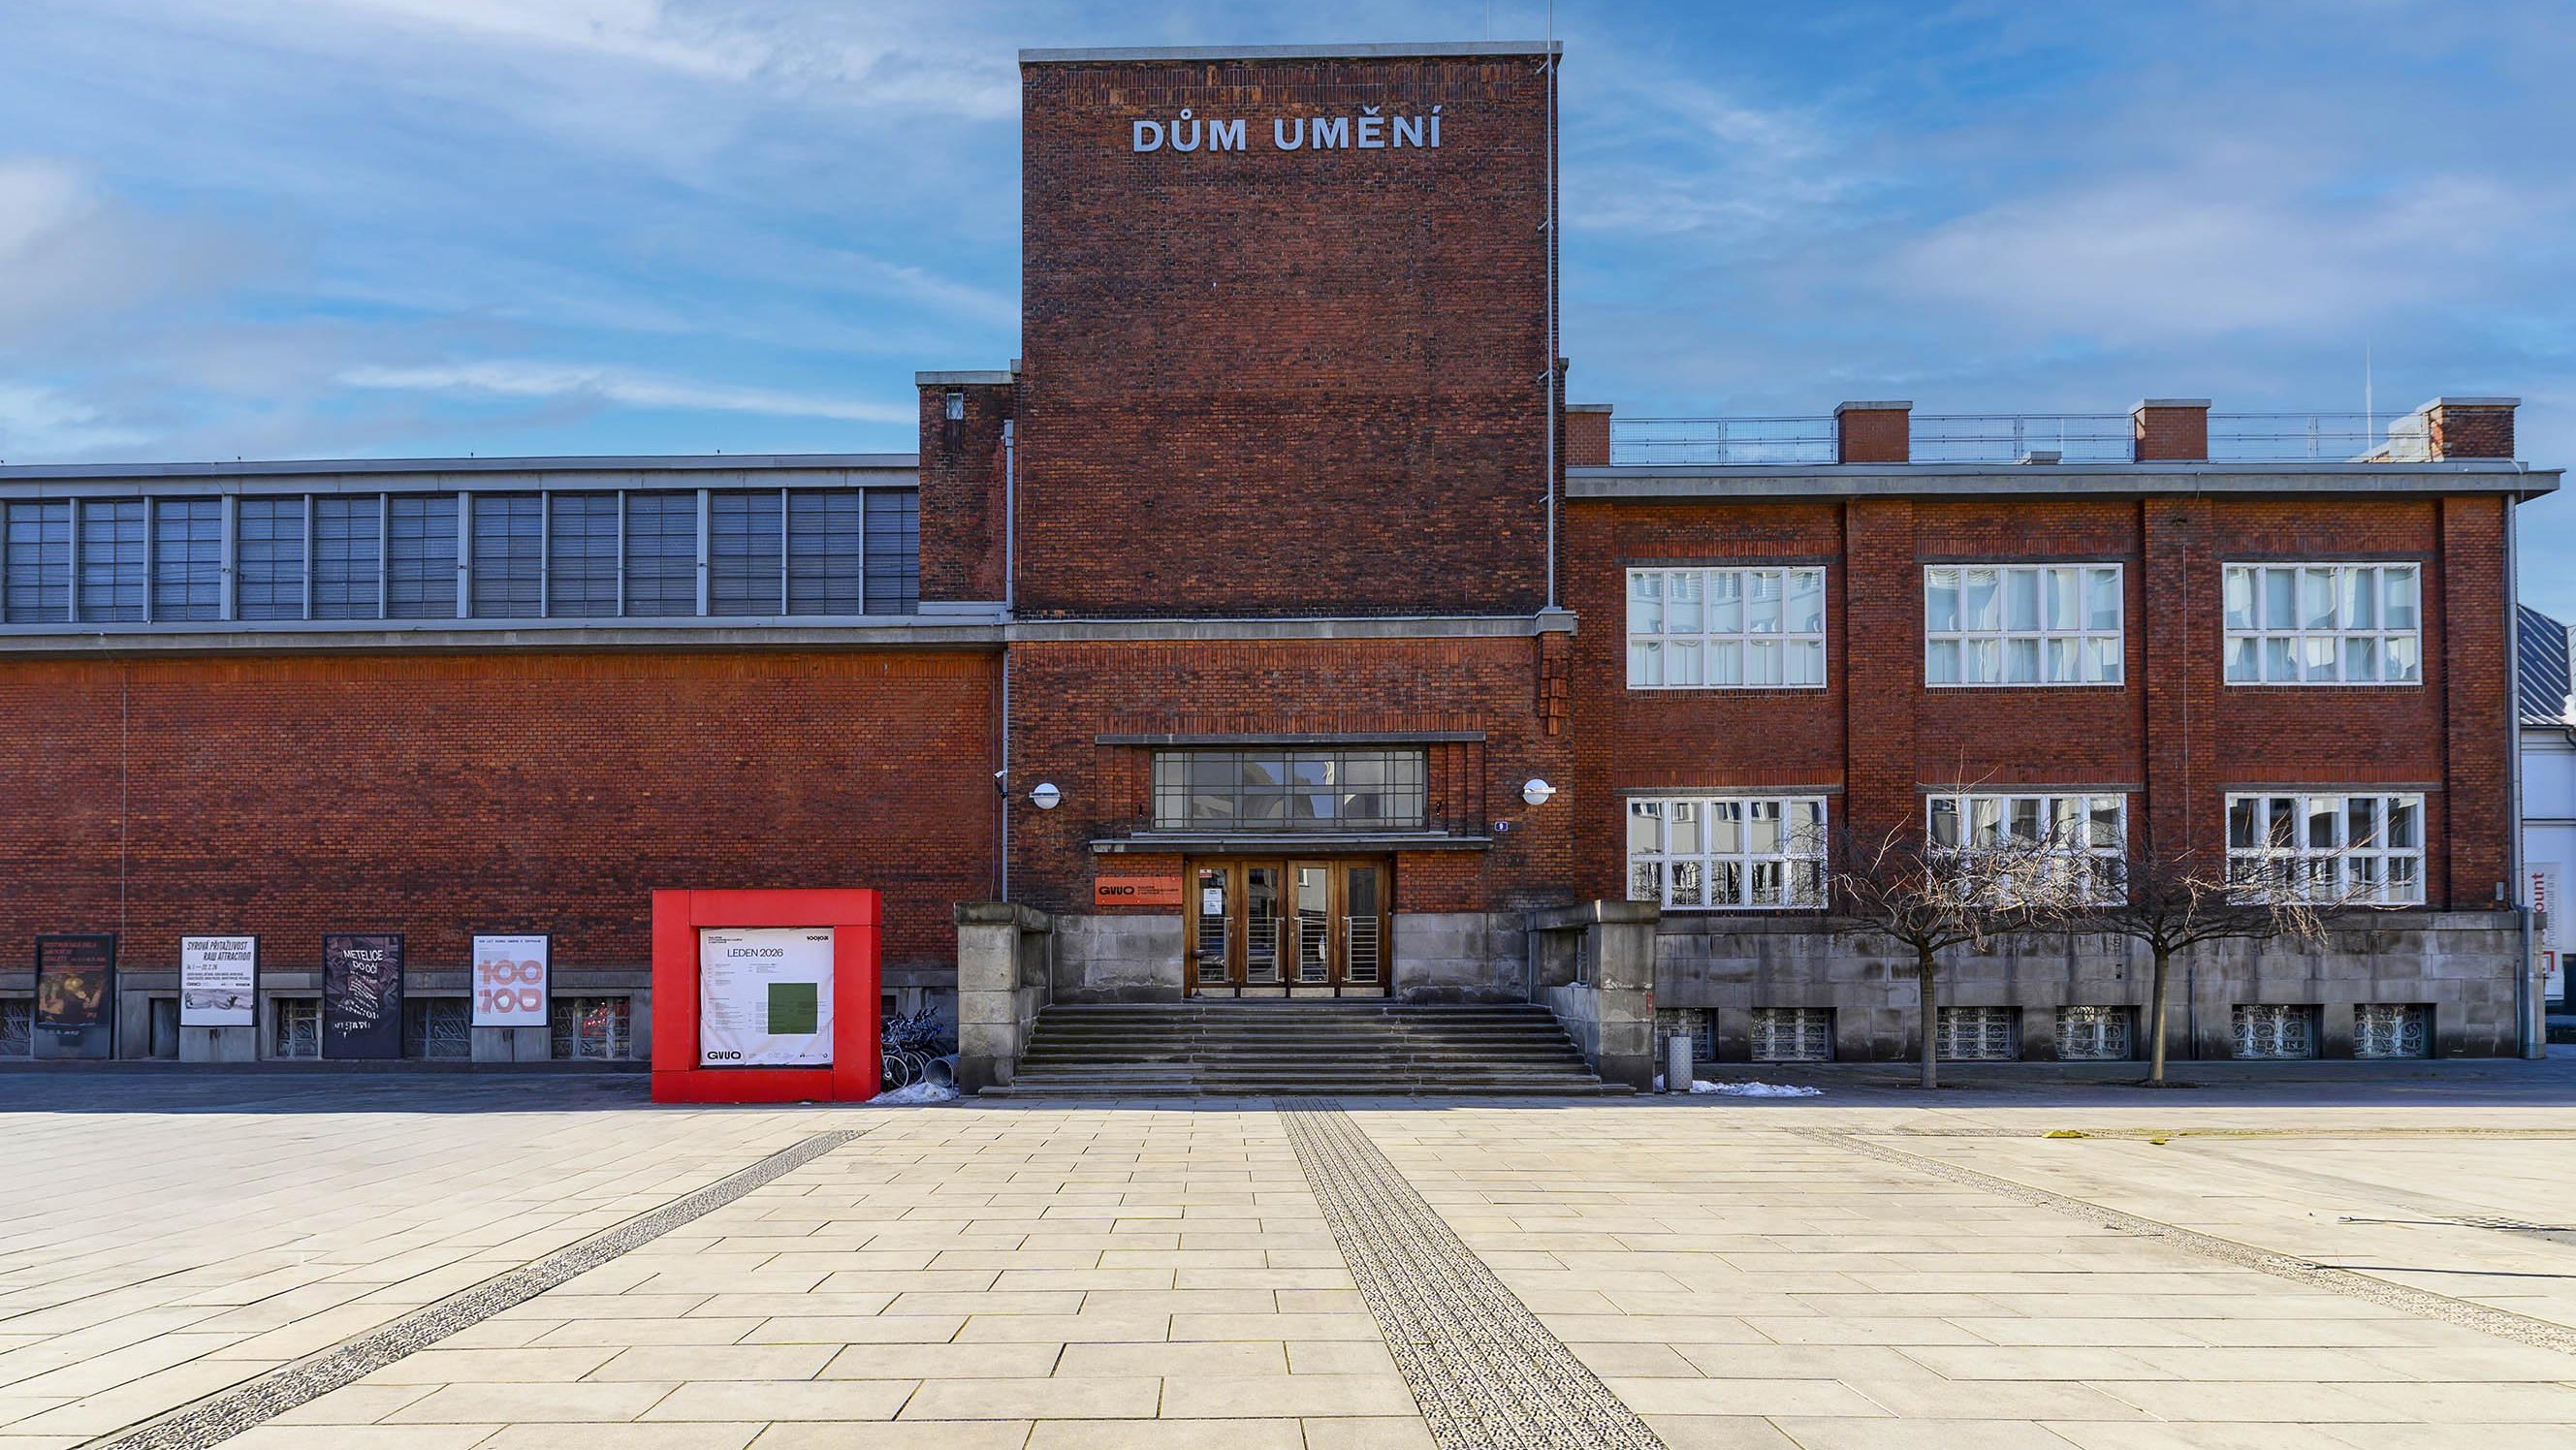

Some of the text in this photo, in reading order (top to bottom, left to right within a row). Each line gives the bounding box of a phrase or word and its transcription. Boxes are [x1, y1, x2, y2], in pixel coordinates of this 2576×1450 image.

[1133, 105, 1443, 151] DŮM UMĚNÍ
[1098, 886, 1135, 896] GVUO
[2530, 872, 2544, 915] ount
[186, 940, 209, 951] SYROVÁ
[204, 952, 251, 961] RAW ATTRACTION
[343, 950, 383, 961] METELICE
[727, 949, 783, 958] LEDEN 2026
[352, 961, 366, 970] DO
[707, 1051, 742, 1059] GVUO
